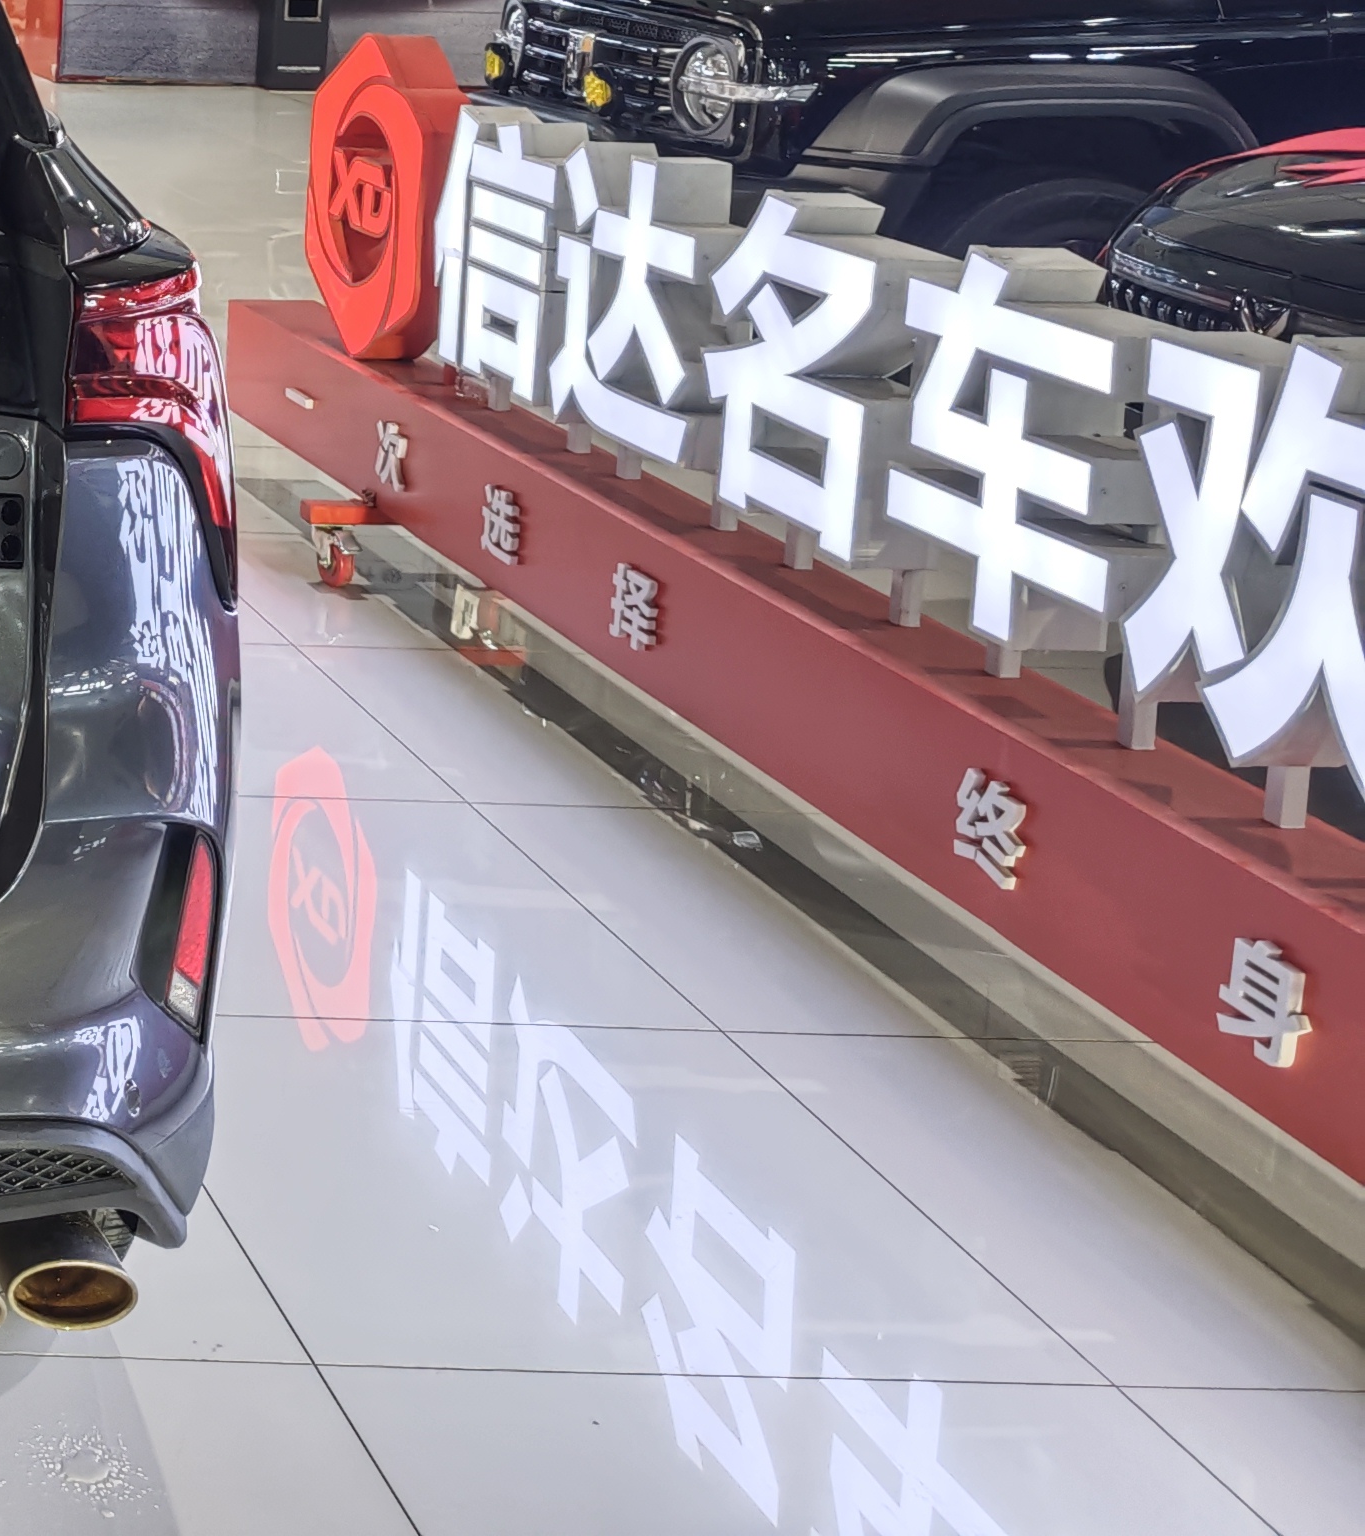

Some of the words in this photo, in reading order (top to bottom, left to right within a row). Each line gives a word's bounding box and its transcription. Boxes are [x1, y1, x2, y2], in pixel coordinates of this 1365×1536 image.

[433, 104, 1365, 802] 信达名车欢
